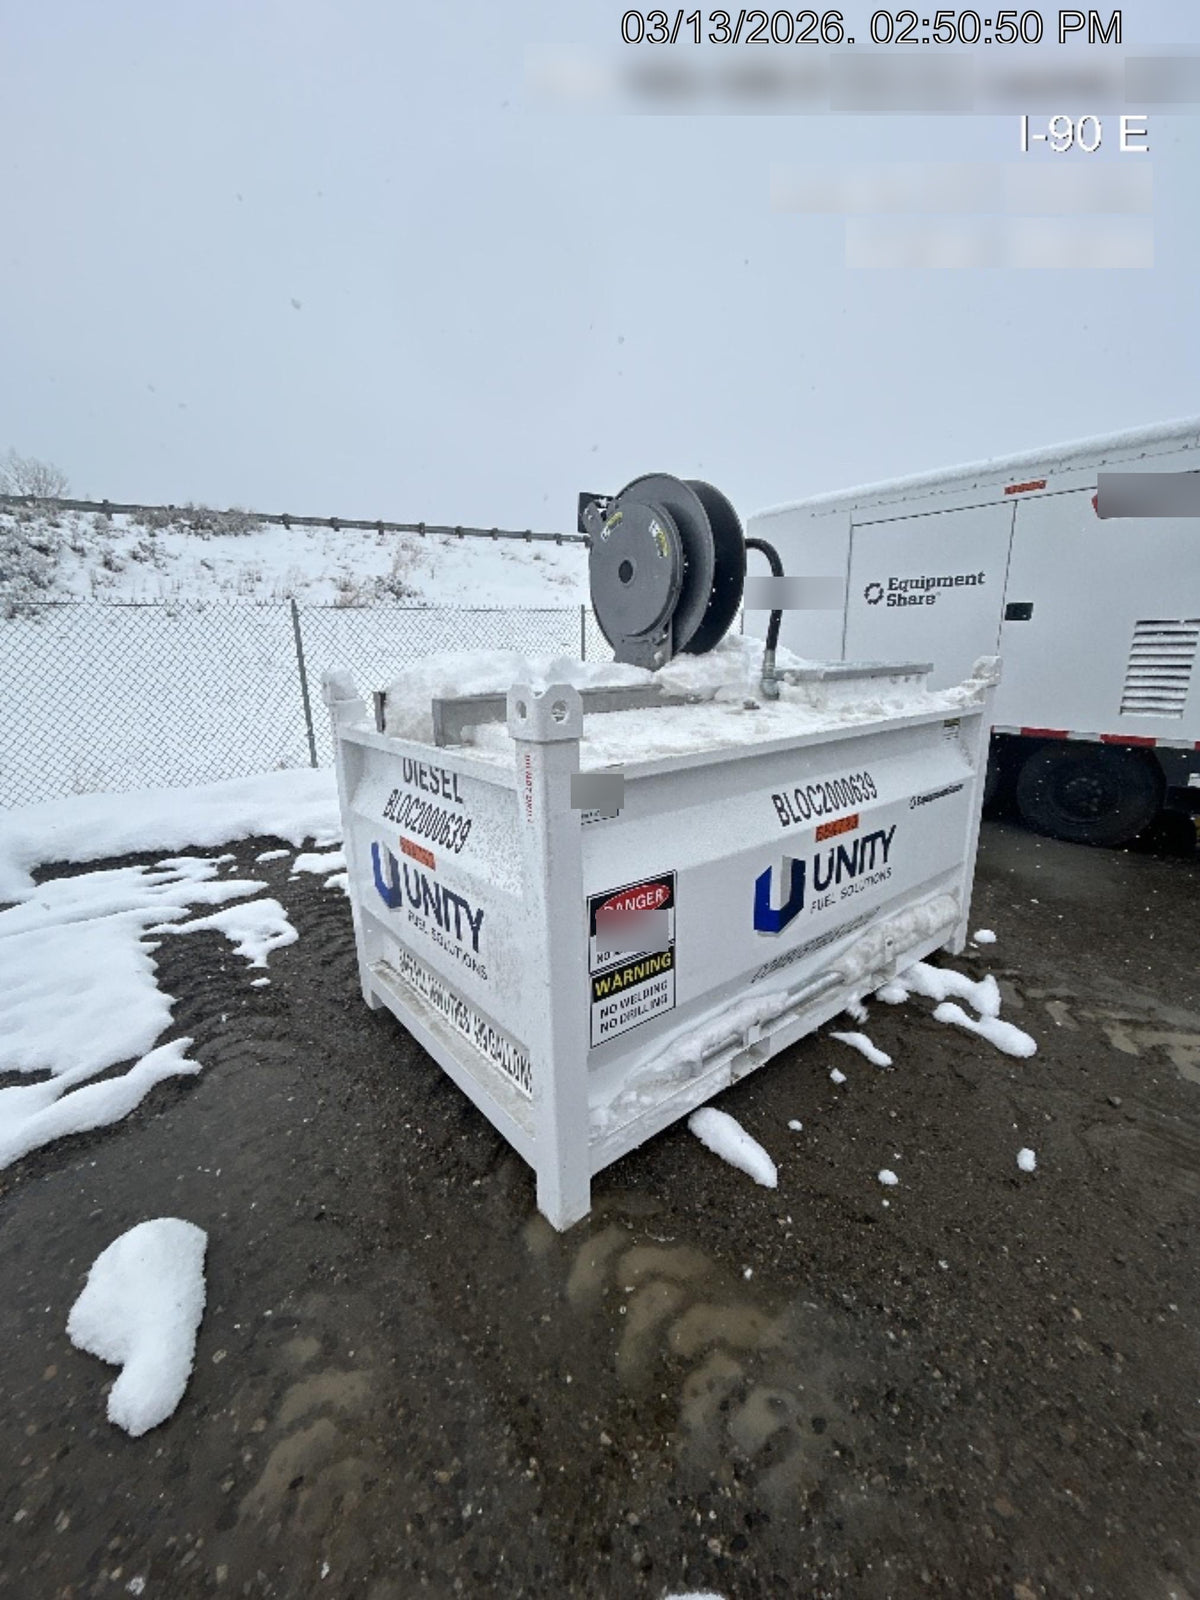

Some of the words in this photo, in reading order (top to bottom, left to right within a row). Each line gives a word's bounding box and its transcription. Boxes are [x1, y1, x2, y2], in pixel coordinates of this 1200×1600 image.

[886, 593, 936, 607] Share
[887, 570, 985, 592] Equipment
[403, 757, 463, 804] DIESEL
[771, 771, 877, 827] BLOC2000639
[382, 789, 472, 854] BLOC2000639
[814, 824, 896, 891] UNITY
[403, 862, 484, 953] UNITY
[595, 952, 672, 997] WARNING
[600, 1003, 618, 1020] NO
[620, 979, 668, 1009] WELDING
[600, 1018, 618, 1034] NO
[620, 993, 668, 1024] DRILLING
